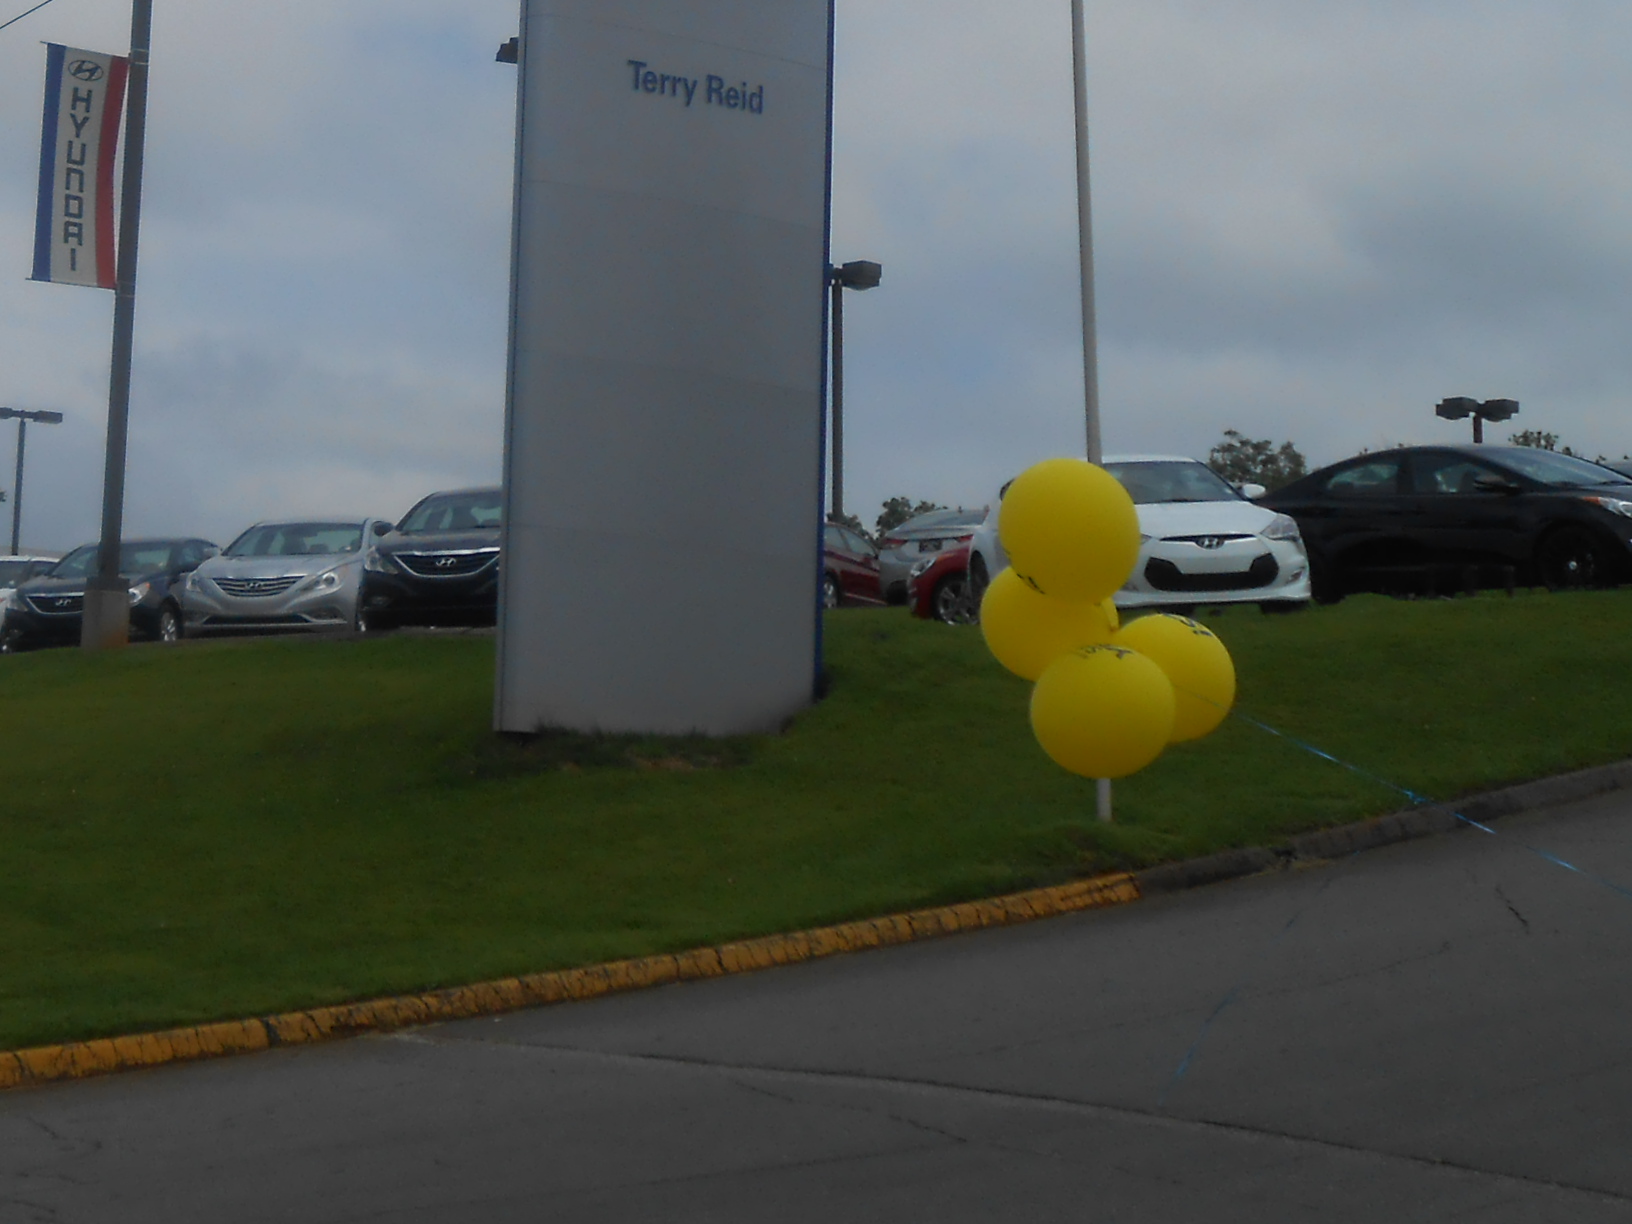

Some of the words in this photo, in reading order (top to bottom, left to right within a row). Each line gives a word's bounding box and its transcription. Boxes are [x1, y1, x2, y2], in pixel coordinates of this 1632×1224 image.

[627, 59, 697, 107] Terry
[705, 74, 764, 115] Reid
[63, 86, 93, 271] HYUNDAI
